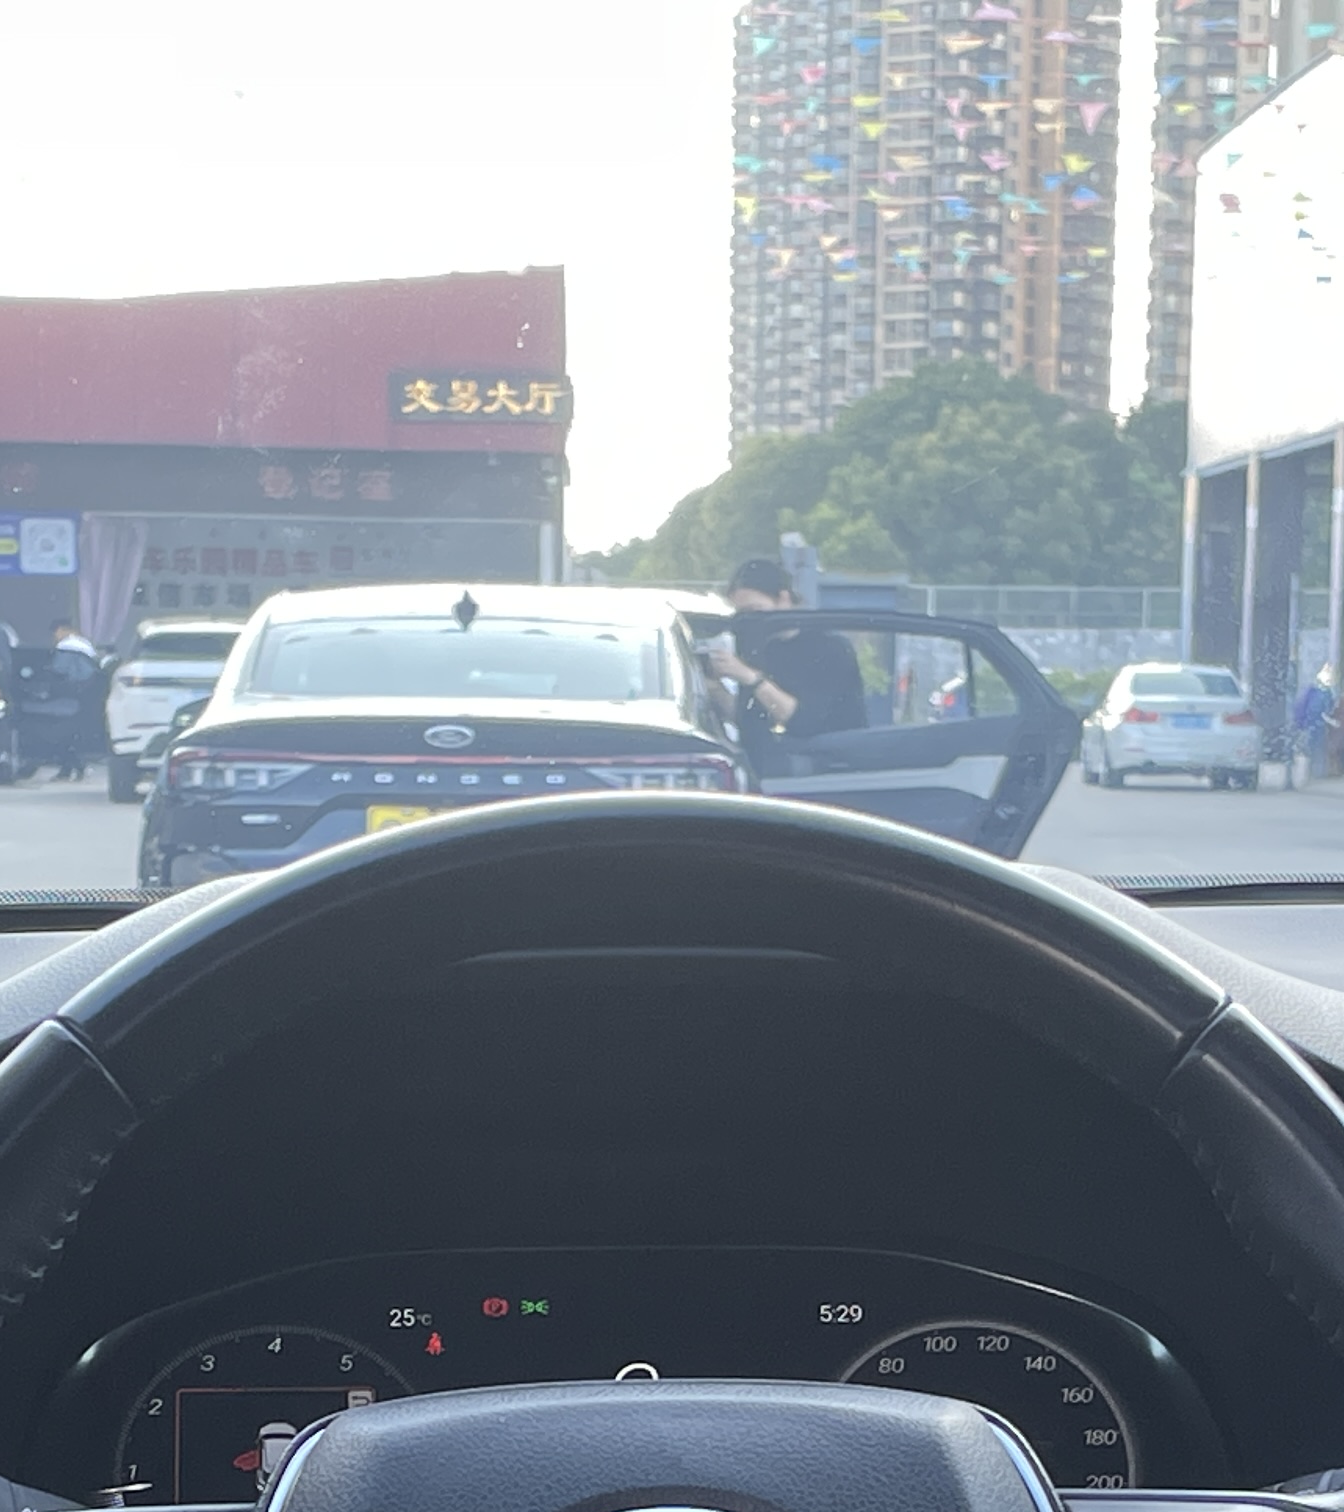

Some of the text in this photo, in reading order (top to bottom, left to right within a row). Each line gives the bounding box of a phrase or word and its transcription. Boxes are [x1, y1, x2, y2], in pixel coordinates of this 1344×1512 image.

[401, 378, 563, 416] 交易大厅
[819, 1303, 863, 1324] 5:29
[266, 1336, 284, 1355] 4
[922, 1334, 958, 1354] 100
[976, 1333, 1011, 1352] 120
[199, 1355, 216, 1372] 3
[338, 1355, 355, 1372] 5
[877, 1356, 906, 1375] 80
[1023, 1354, 1057, 1373] 140
[1060, 1386, 1095, 1405] 160
[147, 1398, 164, 1416] 2
[1082, 1428, 1119, 1447] 180
[127, 1464, 139, 1479] 1
[1085, 1474, 1124, 1489] 200
